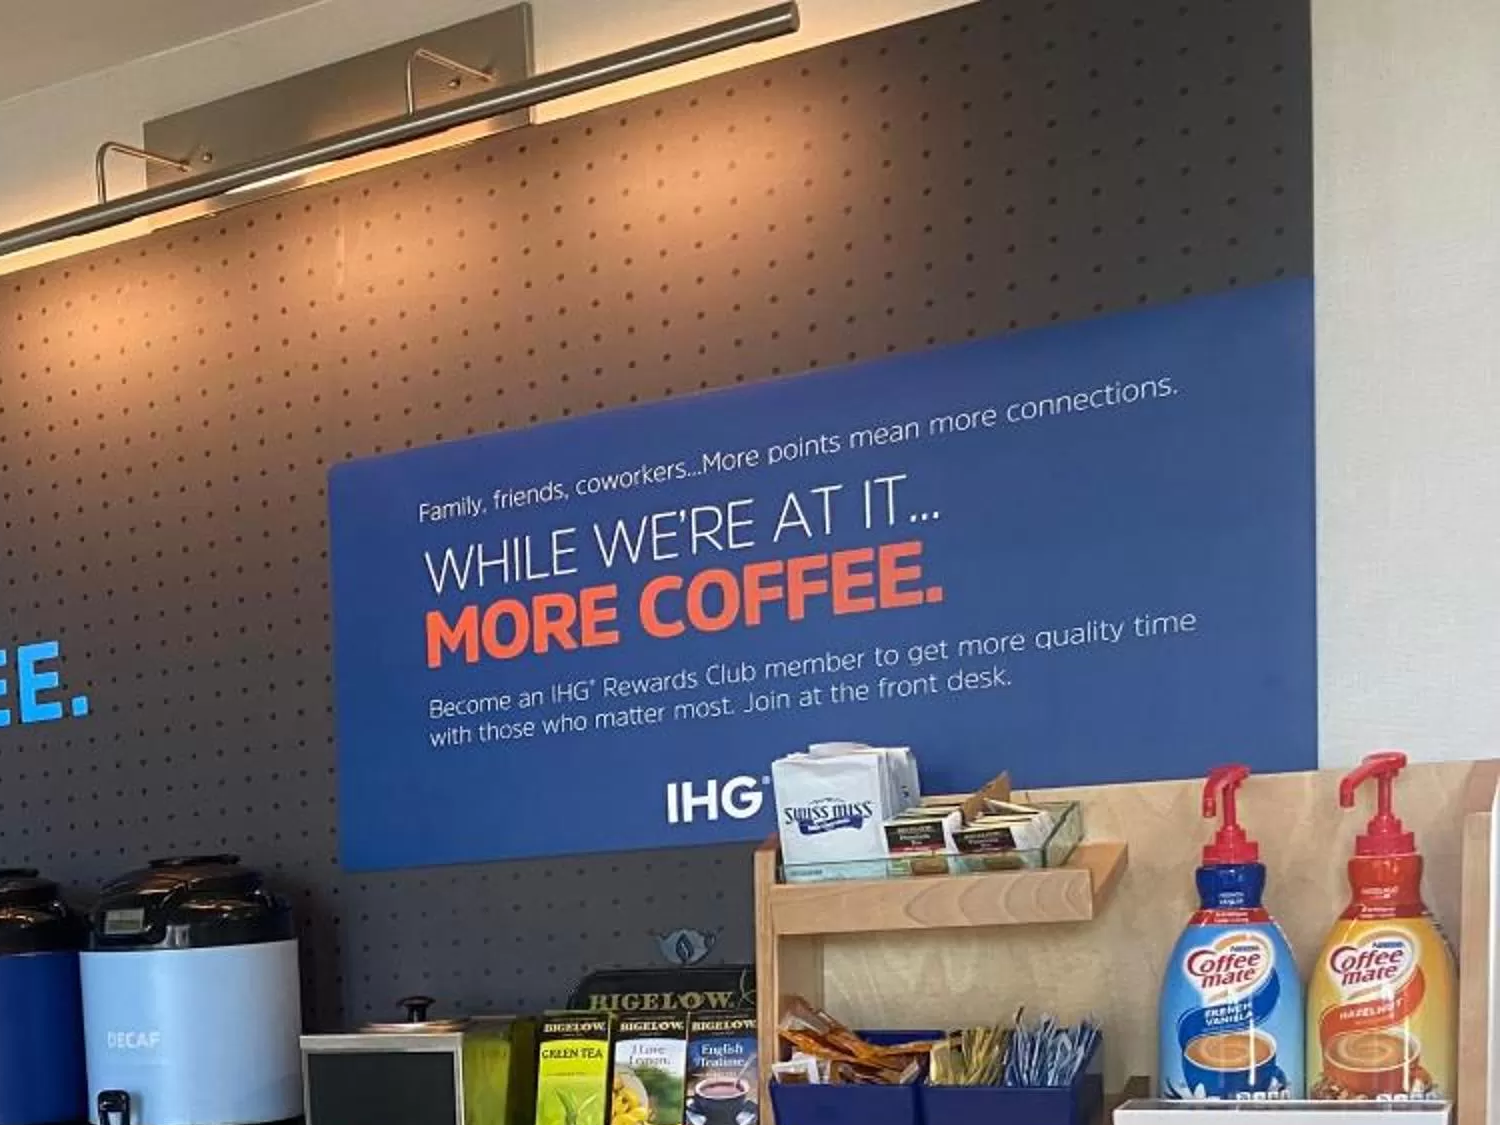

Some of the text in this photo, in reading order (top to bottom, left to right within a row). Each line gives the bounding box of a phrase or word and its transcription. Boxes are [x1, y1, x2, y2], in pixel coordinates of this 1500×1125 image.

[419, 495, 487, 523] Family,
[493, 480, 569, 510] friends,
[768, 432, 841, 465] points
[849, 420, 919, 449] mean
[930, 407, 997, 434] more
[1006, 375, 1178, 424] connections.
[424, 473, 940, 594] WHILE WE'RE AT IT...
[426, 540, 943, 669] MORE COFFEE.
[430, 692, 512, 720] Become
[518, 689, 544, 708] an
[603, 669, 699, 698] Rewards
[706, 662, 757, 686] Club
[765, 649, 865, 679] member
[875, 646, 899, 666] to
[908, 640, 950, 668] get
[958, 633, 1025, 658] more
[1034, 618, 1125, 652] quality
[1133, 611, 1197, 637] time
[430, 666, 1012, 748] with those who matter most. Join at the front desk.
[1187, 950, 1261, 977] Coffee
[1331, 945, 1404, 974] Coffee
[1201, 967, 1257, 989] mate
[1342, 966, 1398, 987] mate
[1340, 998, 1404, 1021] HAZELNT
[107, 1031, 162, 1049] DECAF
